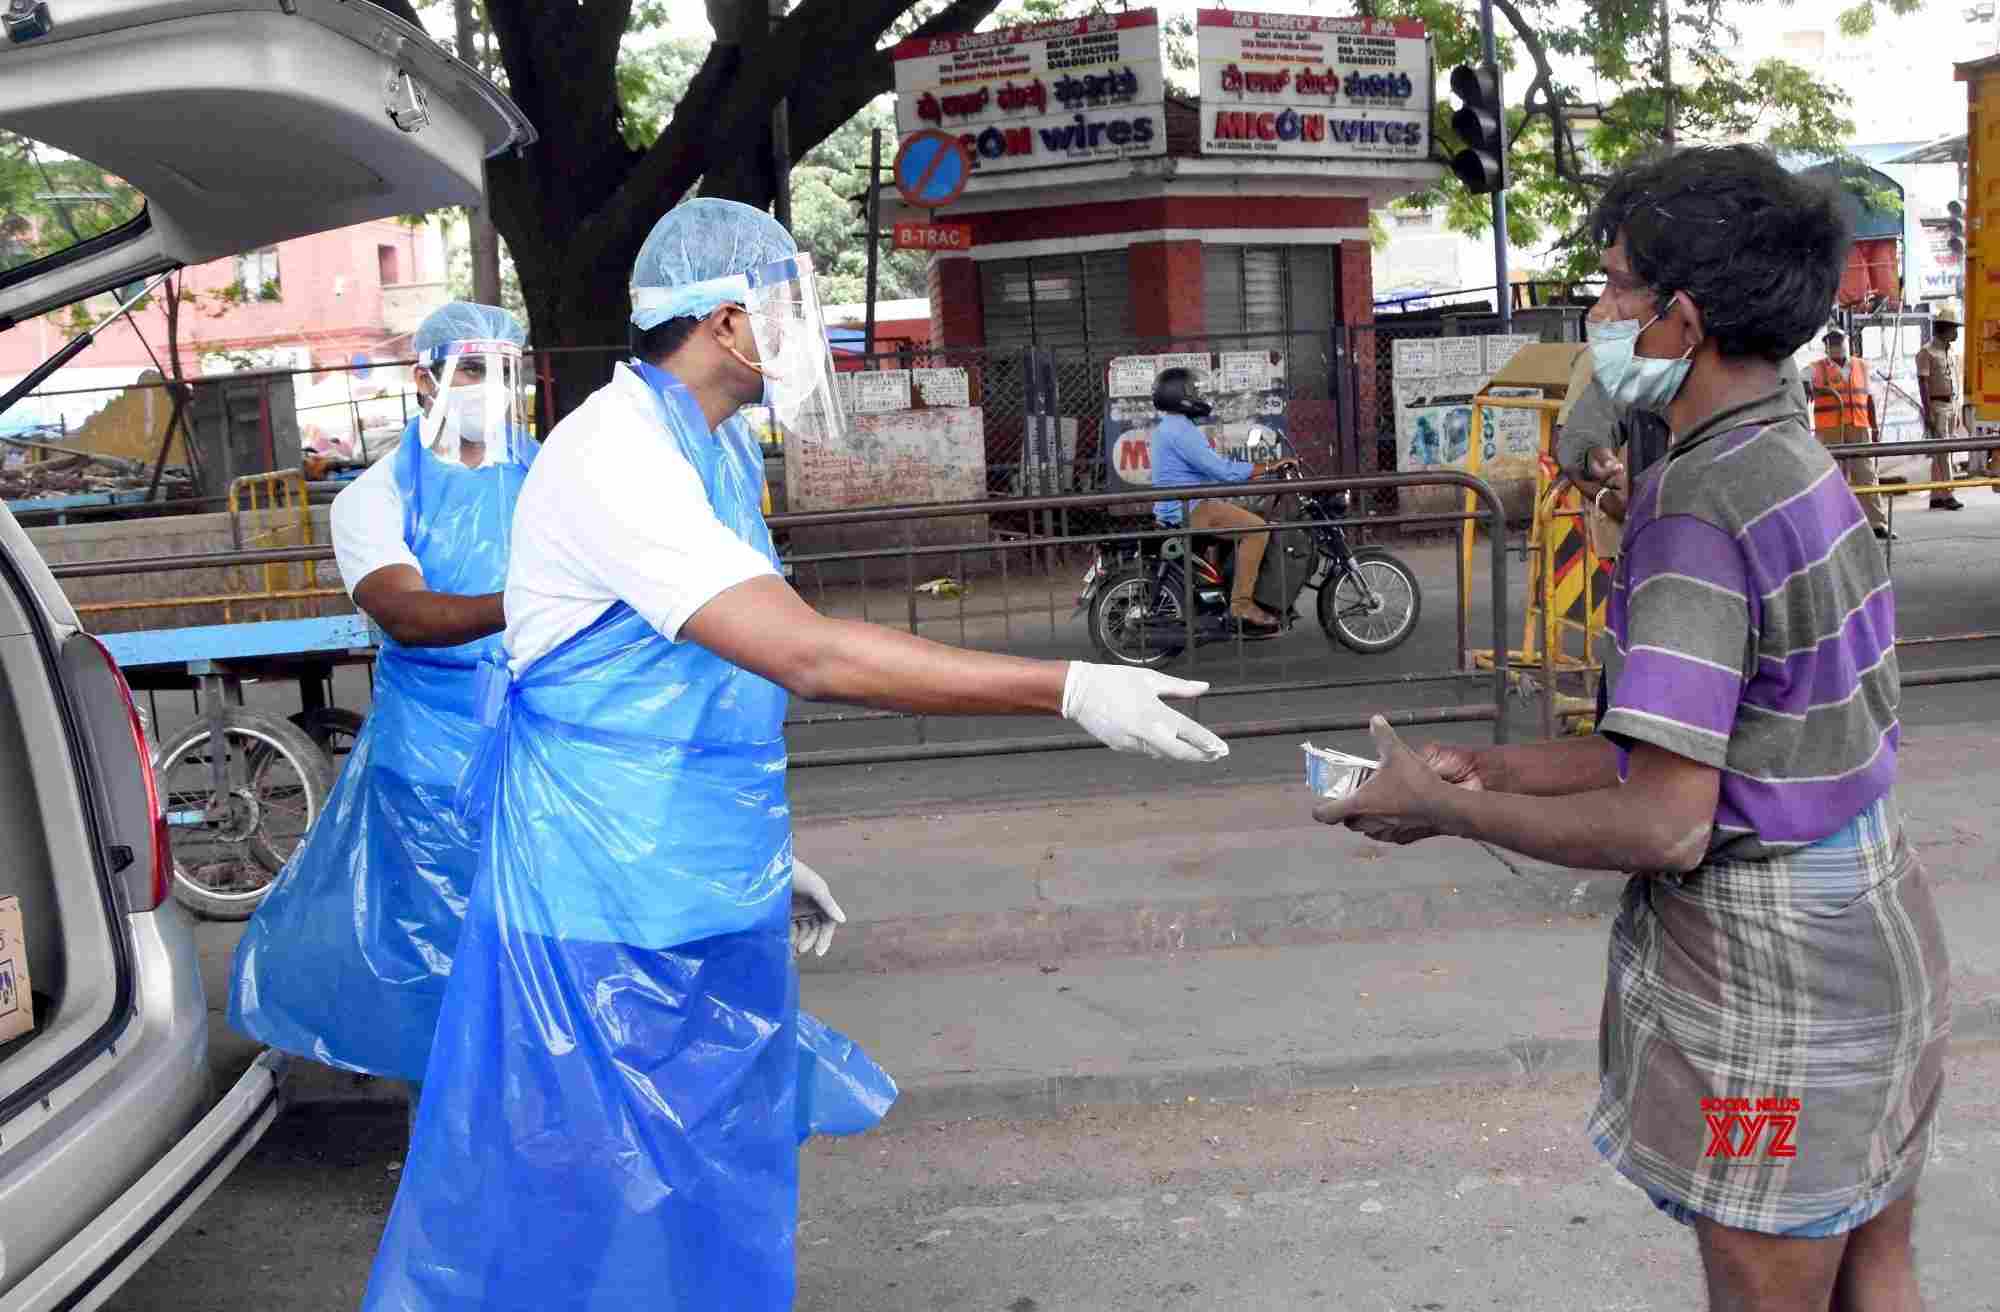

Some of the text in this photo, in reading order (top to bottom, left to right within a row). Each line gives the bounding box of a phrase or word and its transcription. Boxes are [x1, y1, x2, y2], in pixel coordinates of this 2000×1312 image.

[1039, 113, 1154, 151] wires
[1329, 113, 1421, 145] wires
[901, 229, 961, 245] B-TRAC
